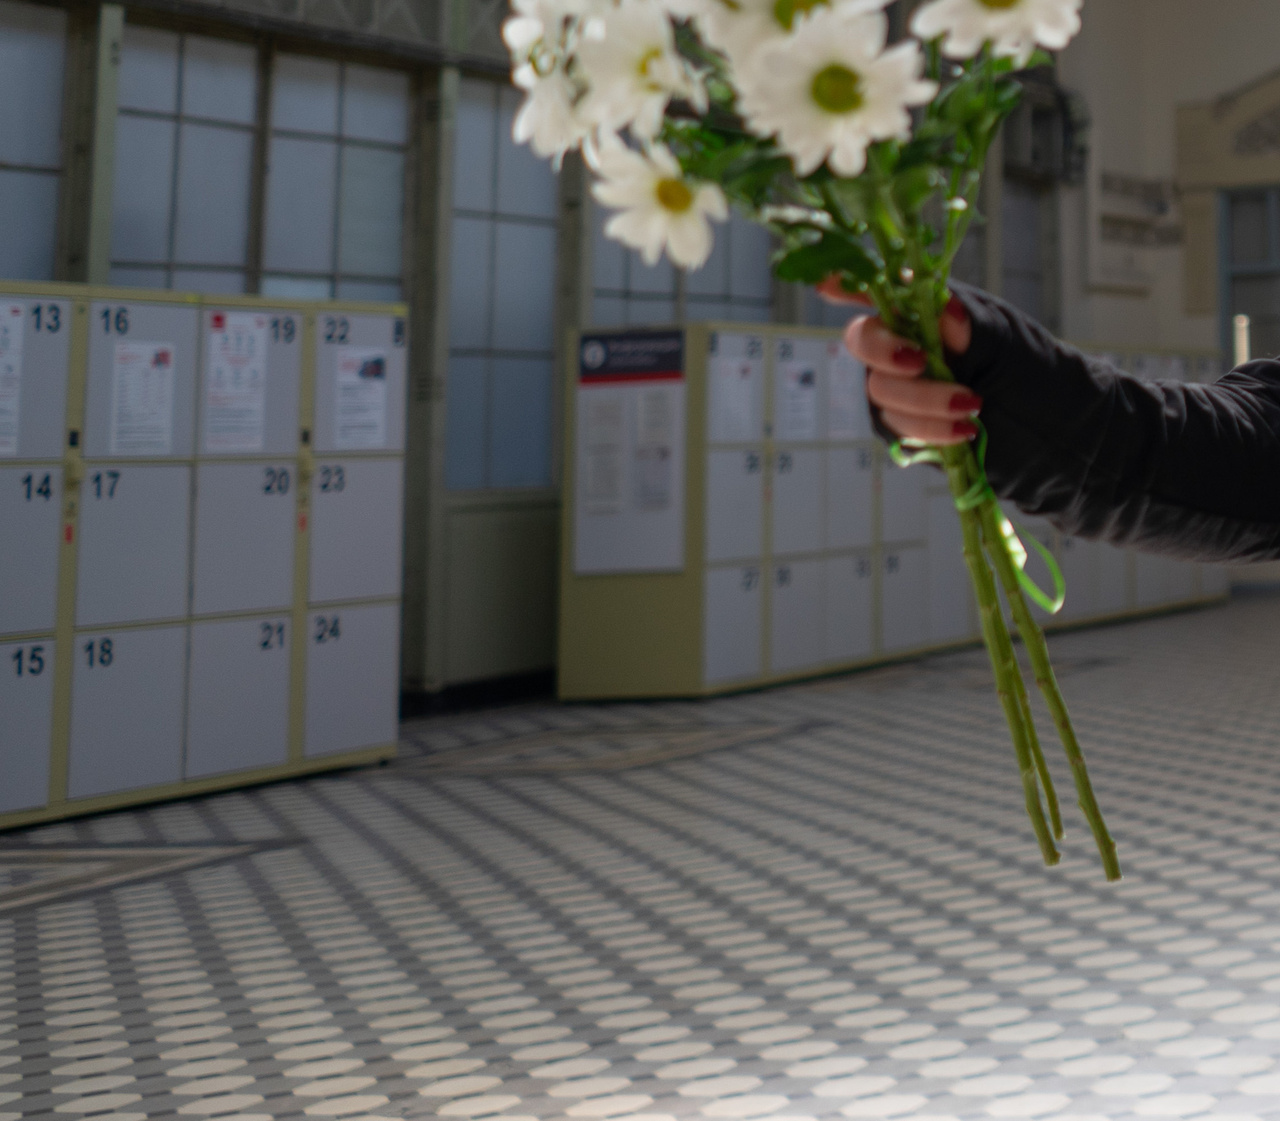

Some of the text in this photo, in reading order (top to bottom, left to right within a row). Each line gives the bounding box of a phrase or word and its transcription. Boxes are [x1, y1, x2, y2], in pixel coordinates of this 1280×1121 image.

[32, 305, 61, 333] 13
[101, 308, 129, 335] 16
[271, 317, 296, 344] 19
[325, 320, 349, 343] 22
[22, 474, 52, 500] 14
[92, 471, 121, 499] 17
[263, 468, 290, 495] 20
[319, 467, 345, 493] 23
[260, 623, 285, 650] 21
[315, 617, 341, 643] 24
[13, 647, 44, 676] 15
[85, 638, 113, 667] 18
